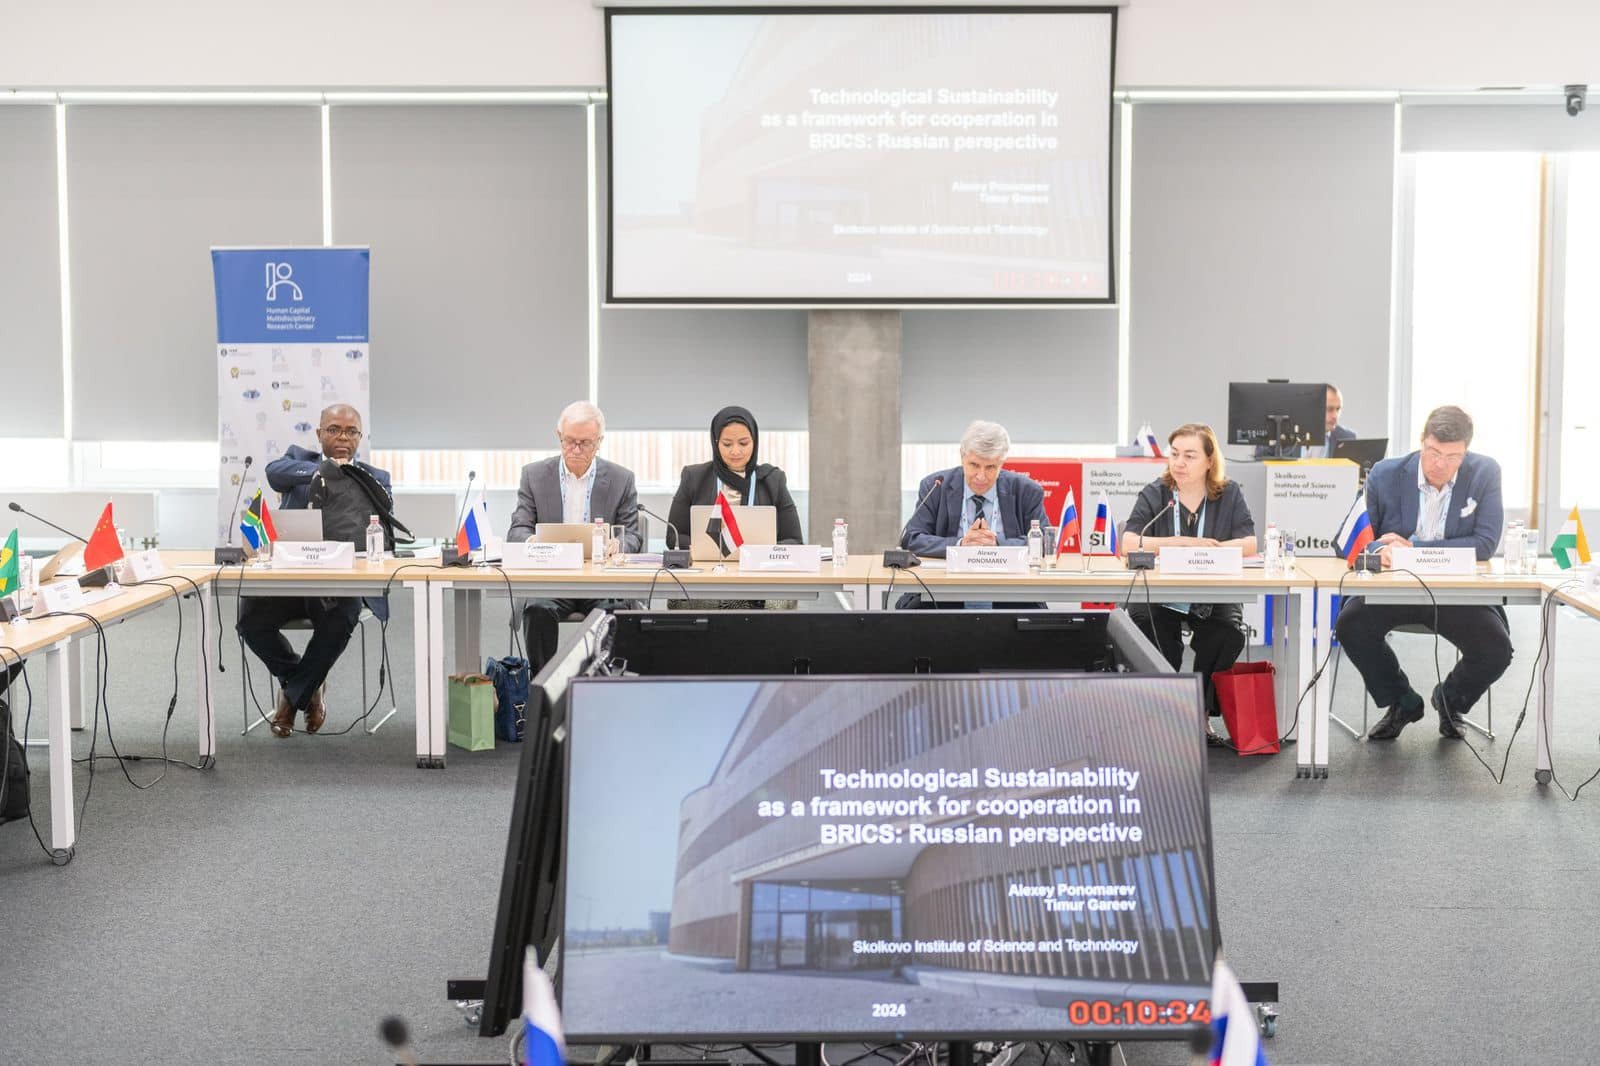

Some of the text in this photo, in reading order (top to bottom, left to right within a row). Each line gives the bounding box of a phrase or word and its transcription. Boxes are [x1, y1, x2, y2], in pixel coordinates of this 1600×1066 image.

[809, 88, 1058, 107] Technological Sustainability
[760, 111, 1058, 130] as a framework for cooperation in
[809, 133, 1058, 152] BRICS: Russian perspective
[266, 306, 311, 315] Human Capital
[820, 767, 1139, 792] Technological Sustainability
[758, 795, 1141, 820] as a framework for cooperation in
[820, 823, 1143, 847] BRICS: Russian perspective
[1008, 884, 1136, 898] Alexey Ponomarev
[1044, 898, 1136, 911] Timur Gareev
[853, 938, 1138, 955] Skolkovo Institute of Science and Technology
[872, 1004, 906, 1018] 2024
[1068, 1000, 1211, 1025] 00:10:34
